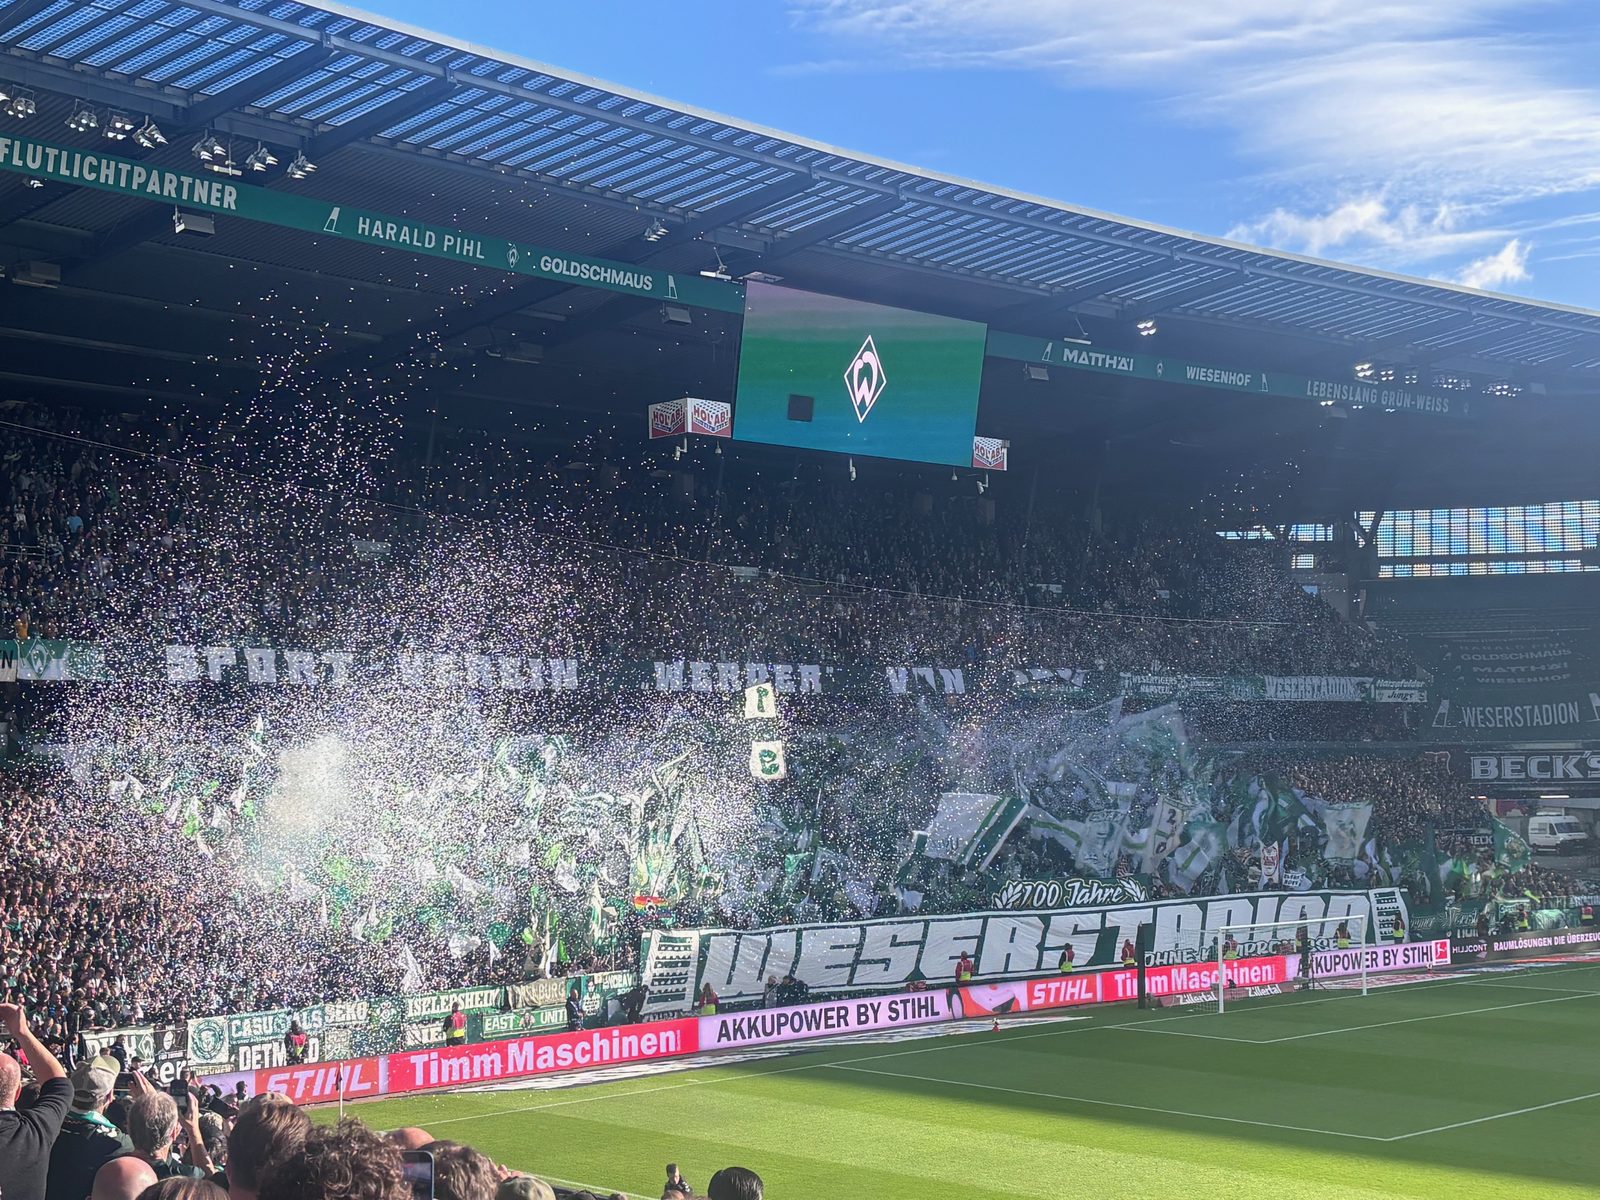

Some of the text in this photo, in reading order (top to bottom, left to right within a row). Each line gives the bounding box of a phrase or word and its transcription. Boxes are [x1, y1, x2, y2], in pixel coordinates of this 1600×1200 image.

[0, 138, 238, 210] FLUTLICHTPARTNER
[358, 216, 485, 260] HARALD PIHL
[540, 255, 653, 291] GOLDSCHMAUS
[1063, 347, 1134, 372] MATTHÄI
[1185, 365, 1252, 387] WIESENHOF
[1306, 379, 1450, 413] LEBENSLANG GRÜN-WEISS
[1460, 649, 1572, 661] GOLDSCHMAUS
[1476, 673, 1571, 684] WIESENHOF
[1461, 700, 1579, 728] WESERSTADION
[1064, 880, 1122, 906] Jahre
[701, 895, 1370, 999] WESERSTADION
[1493, 937, 1552, 952] RAUMLÖSUNGEN
[1553, 935, 1566, 946] DIE
[1144, 947, 1198, 968] OHNE
[1382, 948, 1399, 967] BY
[1031, 975, 1093, 1005] STIHL
[1177, 991, 1218, 1005] Zillertal
[1248, 983, 1282, 998] Zillertal
[485, 1008, 568, 1032] EAST UNIT
[716, 996, 941, 1043] AKKUPOWER BY STIHL
[410, 1028, 676, 1086] Timm Maschinen
[266, 1062, 374, 1099] STIHL
